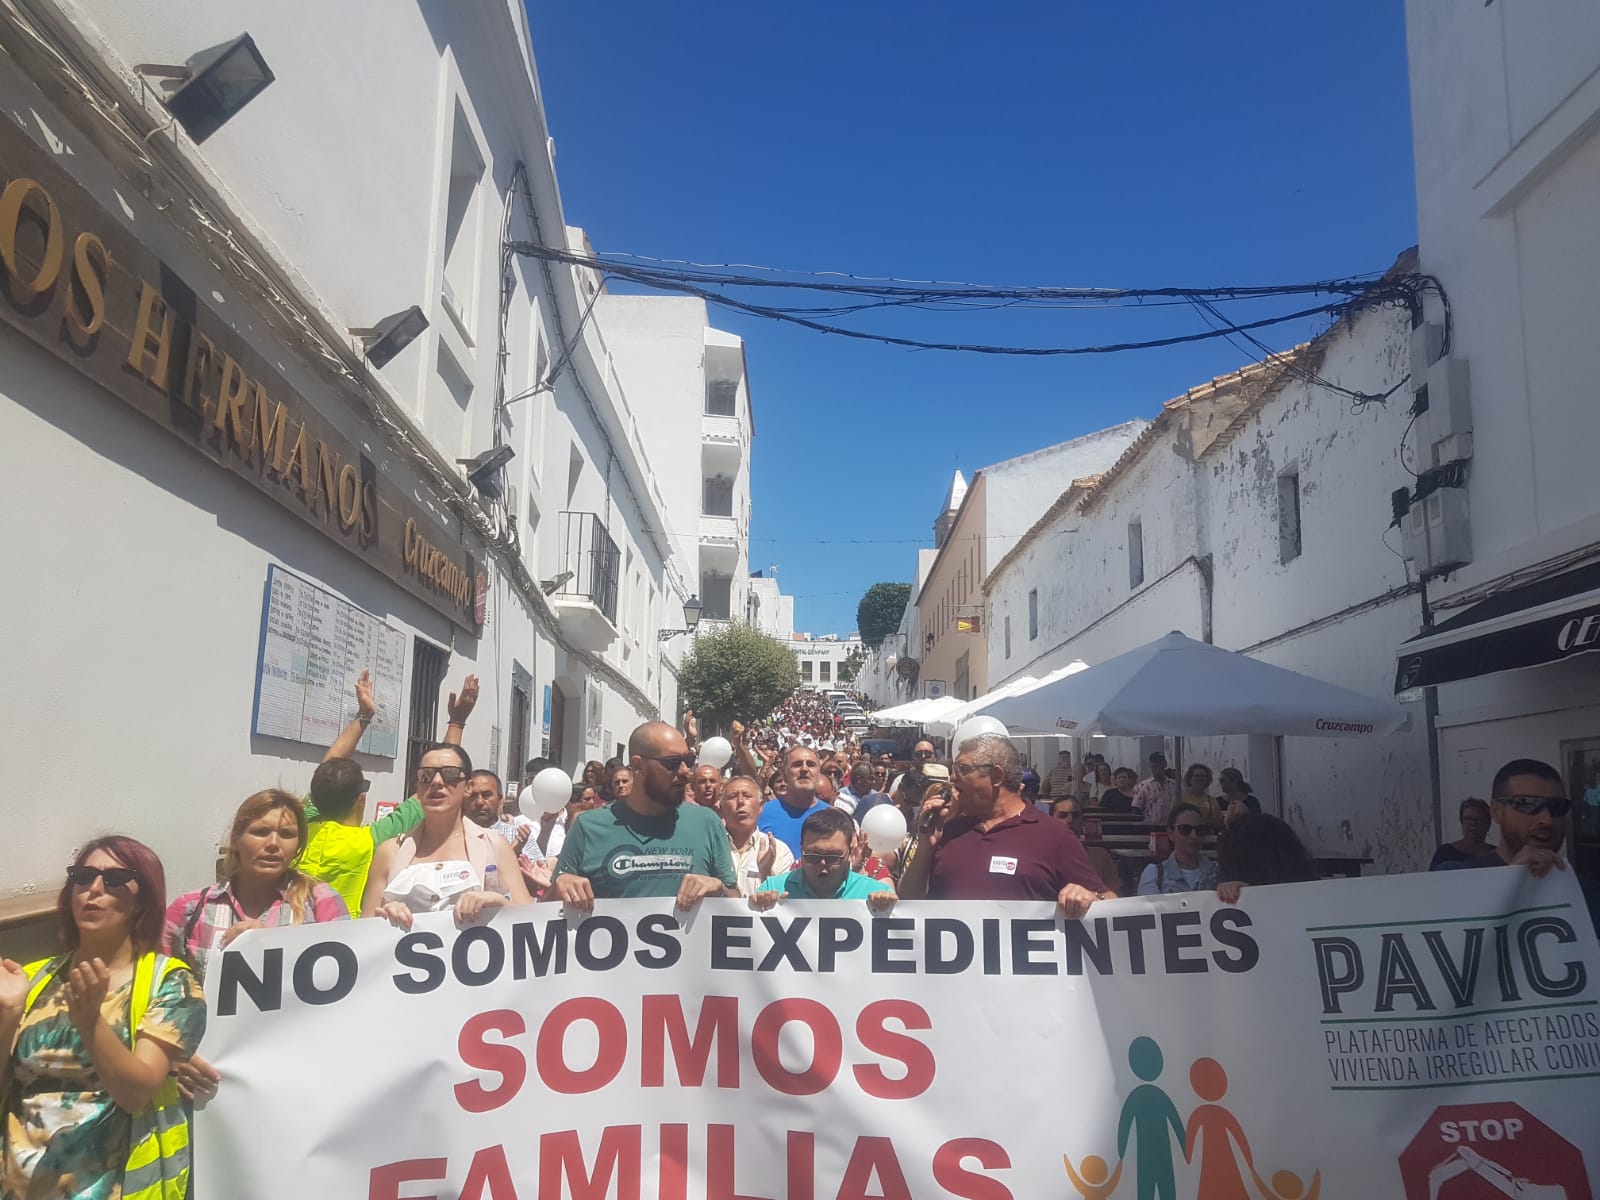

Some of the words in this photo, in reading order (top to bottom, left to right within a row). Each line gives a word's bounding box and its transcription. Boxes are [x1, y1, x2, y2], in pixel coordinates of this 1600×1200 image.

[126, 279, 377, 539] HERMANOS
[404, 516, 472, 608] Cruzcampo
[1315, 718, 1374, 735] Cruzcampo
[613, 857, 690, 872] Champion
[645, 846, 667, 856] NEW
[670, 847, 695, 857] YORK
[216, 940, 358, 1017] NO
[391, 914, 683, 994] SOMOS
[711, 906, 1260, 976] EXPEDIENTES
[1311, 916, 1588, 1014] PAVIC
[453, 995, 937, 1113] SOMOS
[1324, 1025, 1449, 1054] PLATAFORMA
[1454, 1023, 1478, 1049] DE
[1484, 1012, 1600, 1046] AFECTADOS
[1327, 1056, 1420, 1081] VIVIENDA
[1425, 1047, 1540, 1080] IRREGULAR
[1439, 1117, 1524, 1143] STOP
